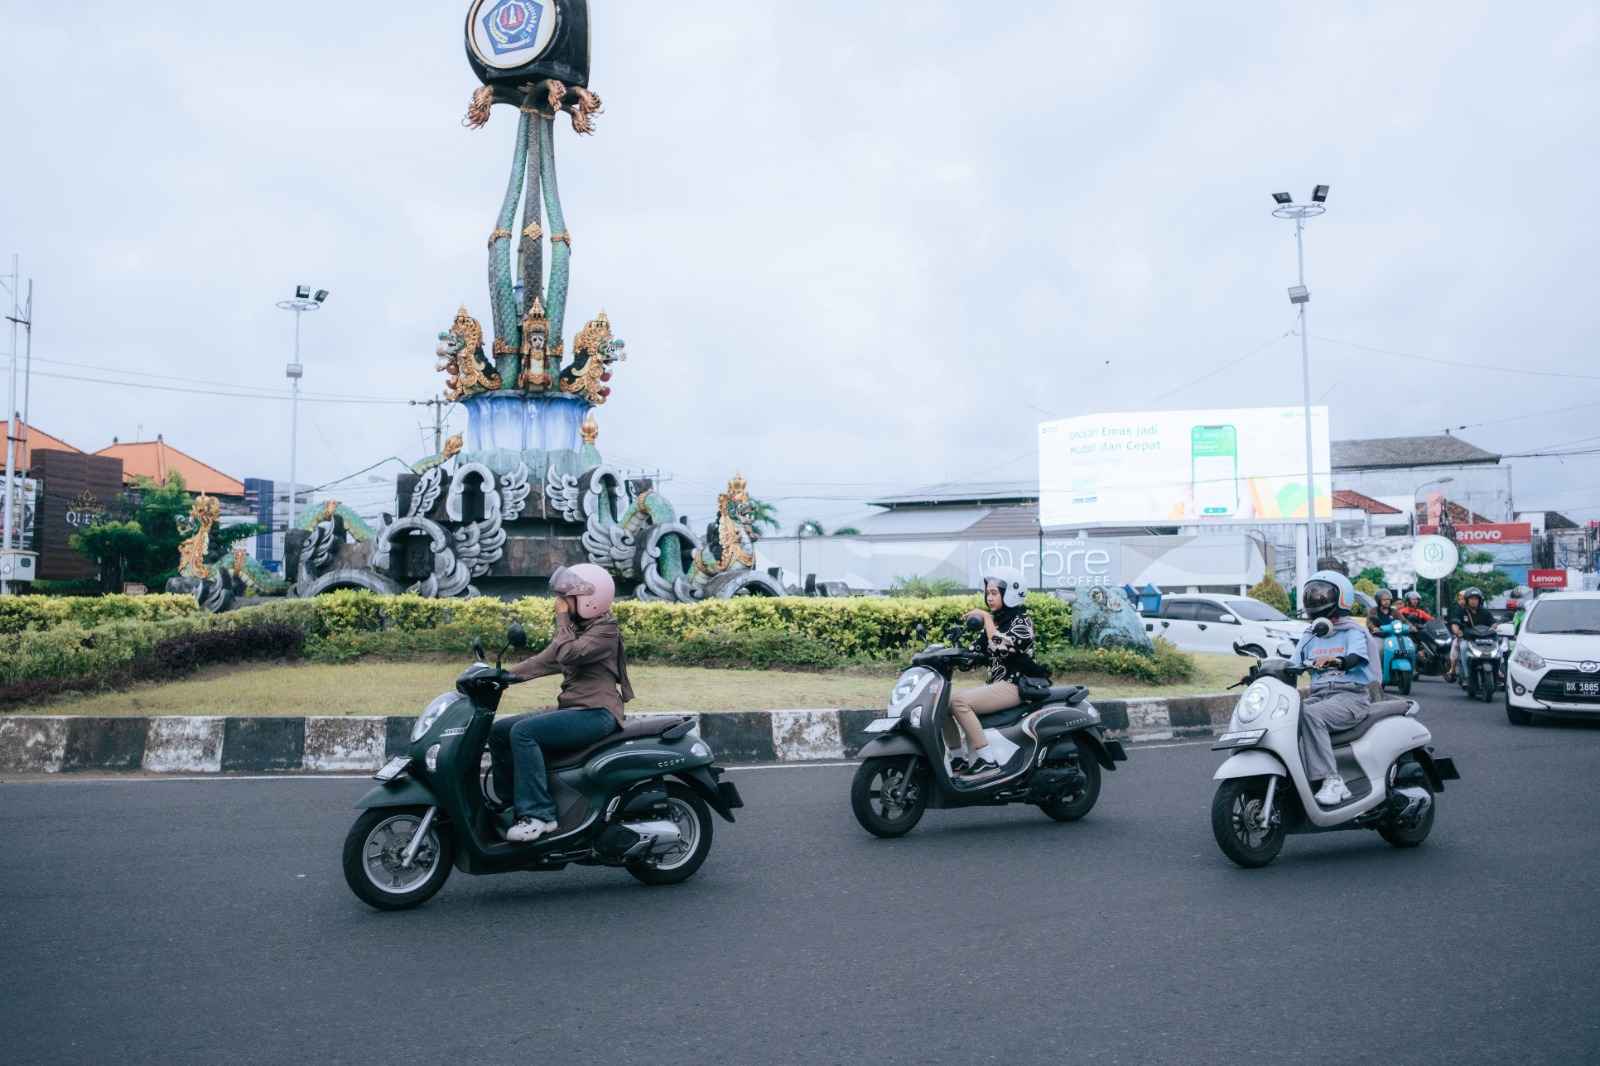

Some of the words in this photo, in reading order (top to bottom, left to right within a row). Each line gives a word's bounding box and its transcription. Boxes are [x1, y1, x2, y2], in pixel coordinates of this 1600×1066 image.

[1455, 529, 1503, 541] enovo
[1056, 575, 1112, 587] COFFEE
[1531, 574, 1563, 584] Lenovo
